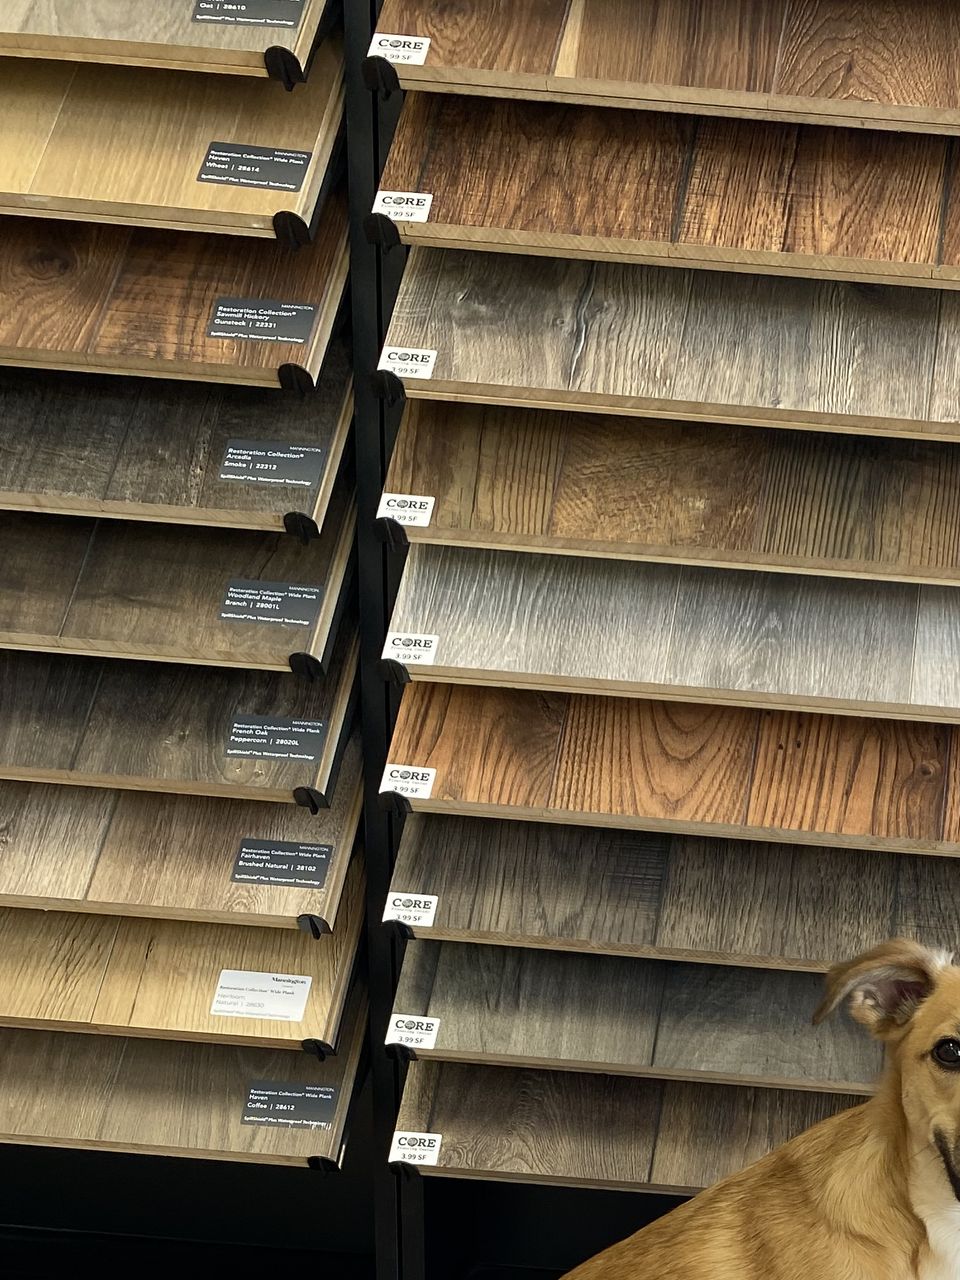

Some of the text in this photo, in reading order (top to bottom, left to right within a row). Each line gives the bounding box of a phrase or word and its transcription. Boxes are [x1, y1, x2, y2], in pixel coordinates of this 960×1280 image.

[378, 39, 423, 50] CORE
[206, 161, 228, 169] Wheat
[382, 196, 426, 206] CORE
[244, 313, 269, 321] Hickory
[388, 352, 430, 363] CORE
[224, 460, 246, 468] Smoke
[386, 499, 428, 510] CORE
[228, 592, 260, 600] Woodland
[392, 638, 433, 648] CORE
[390, 770, 430, 781] CORE
[392, 898, 432, 909] CORE
[395, 1020, 434, 1031] CORE
[398, 1137, 437, 1148] CORE
